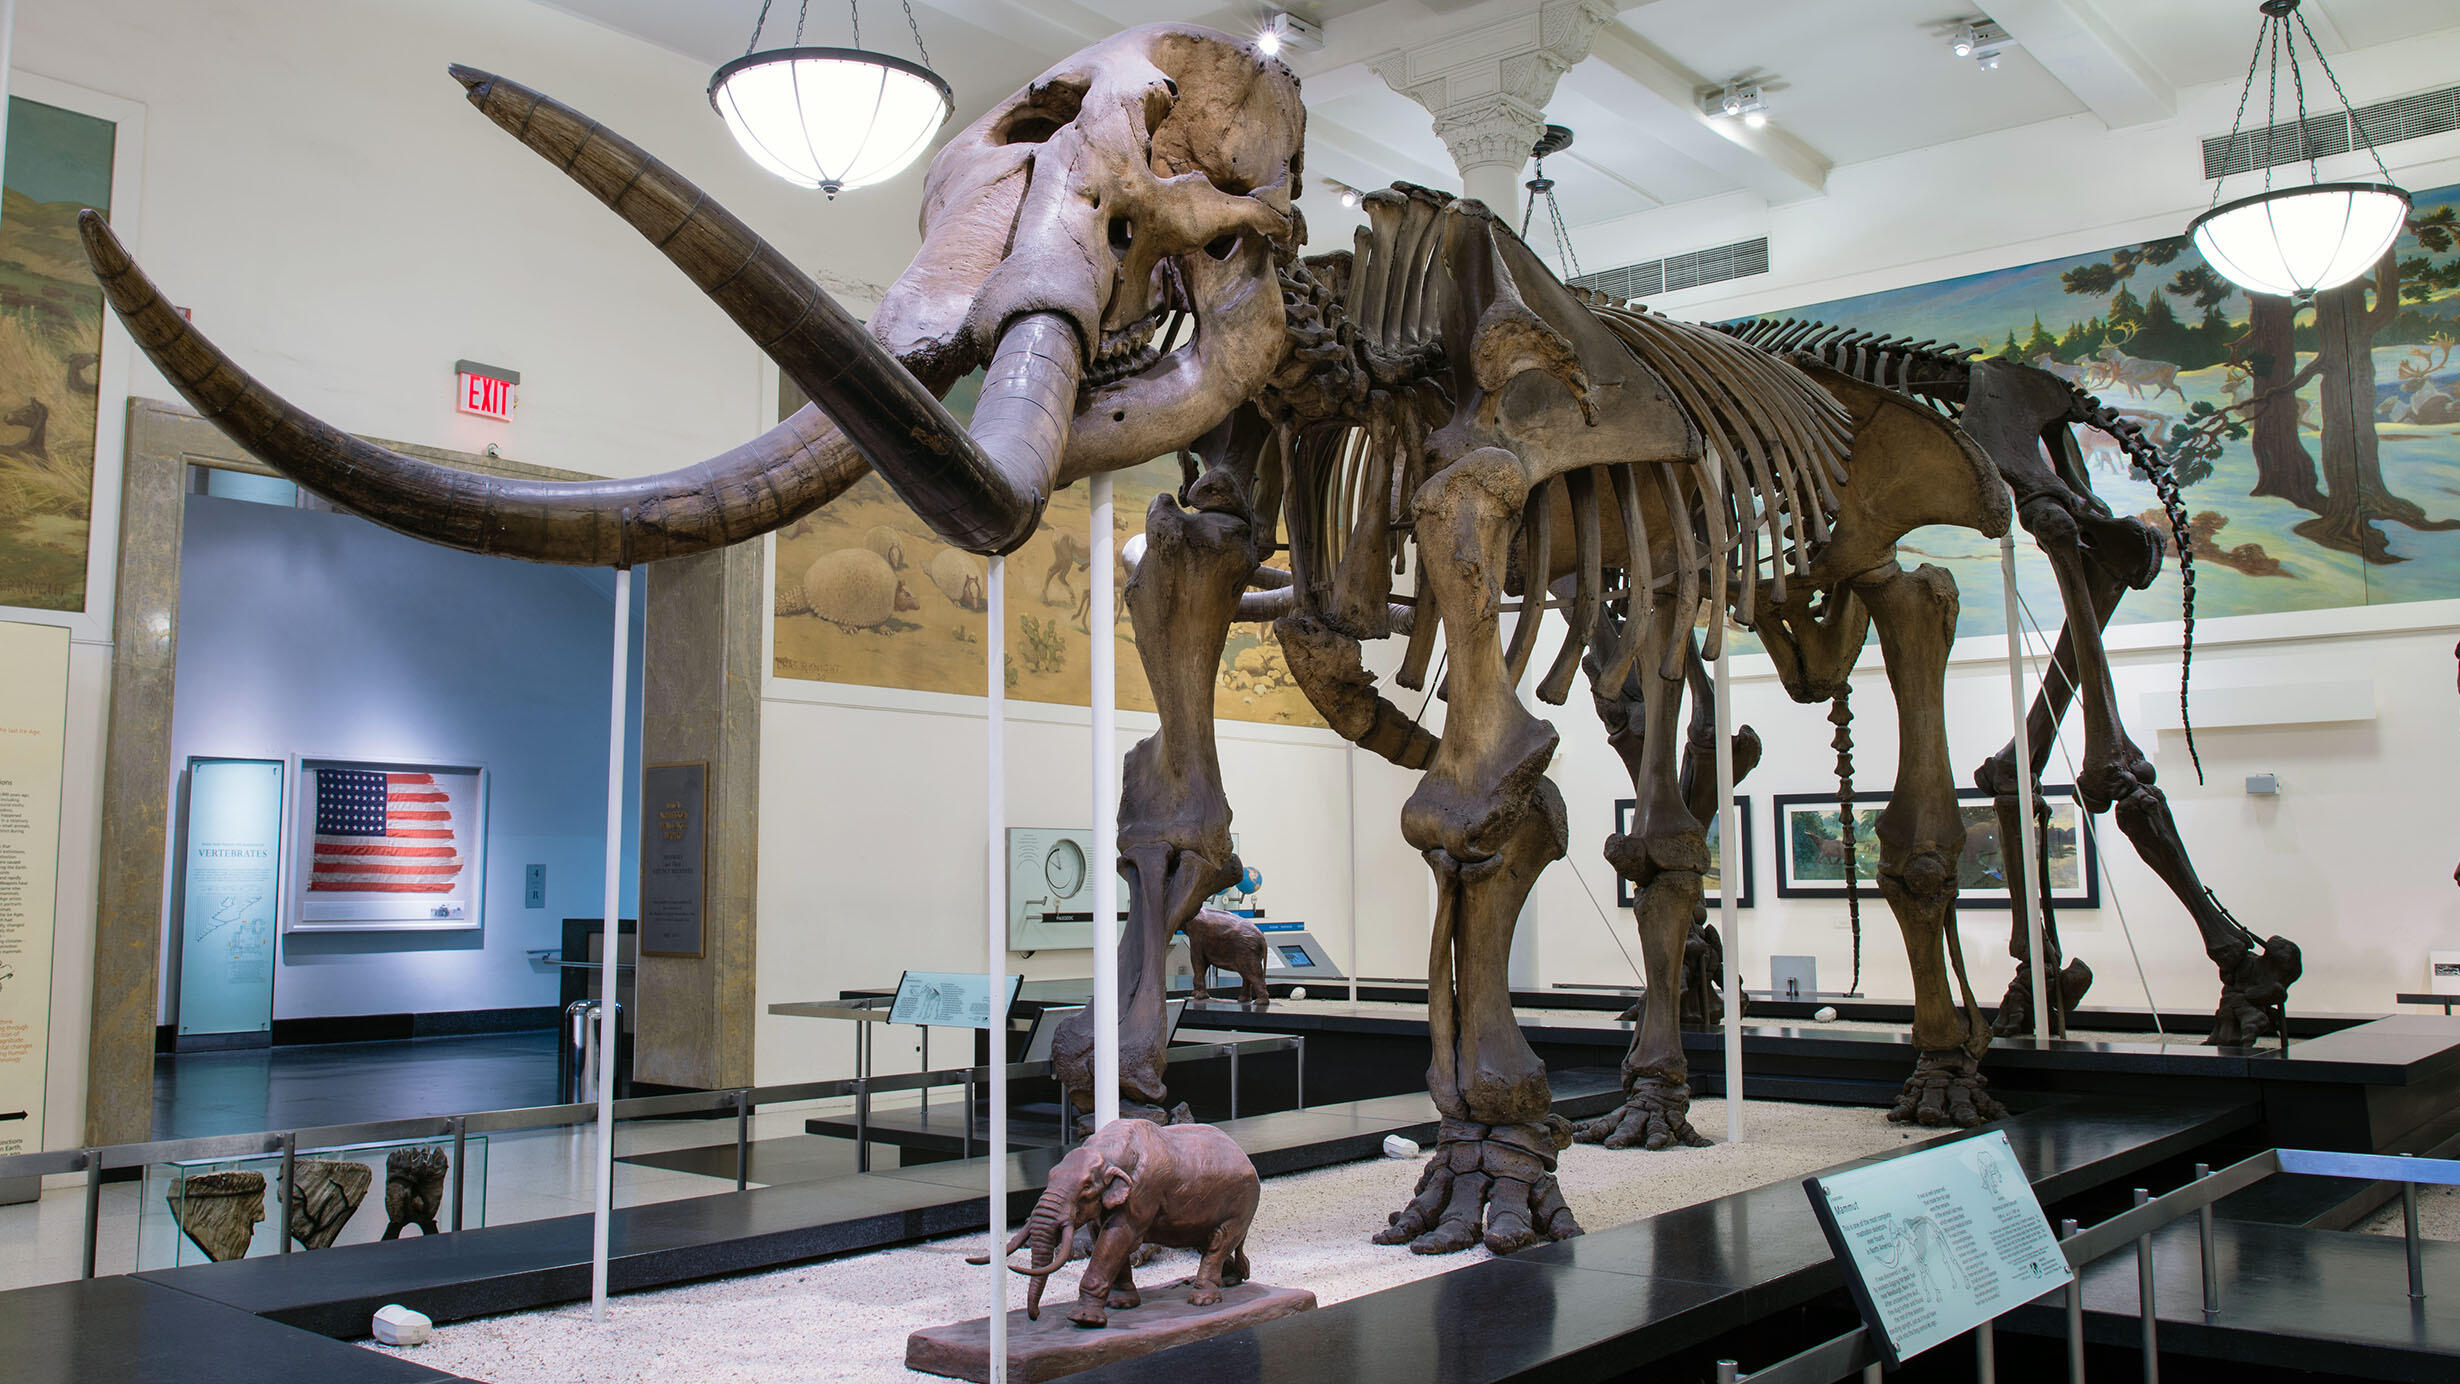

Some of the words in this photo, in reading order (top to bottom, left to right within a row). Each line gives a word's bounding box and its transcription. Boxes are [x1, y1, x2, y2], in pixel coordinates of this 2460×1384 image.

[468, 374, 510, 417] EXIT
[198, 848, 268, 857] VERTEBRATES
[1834, 1201, 1859, 1215] Mammut
